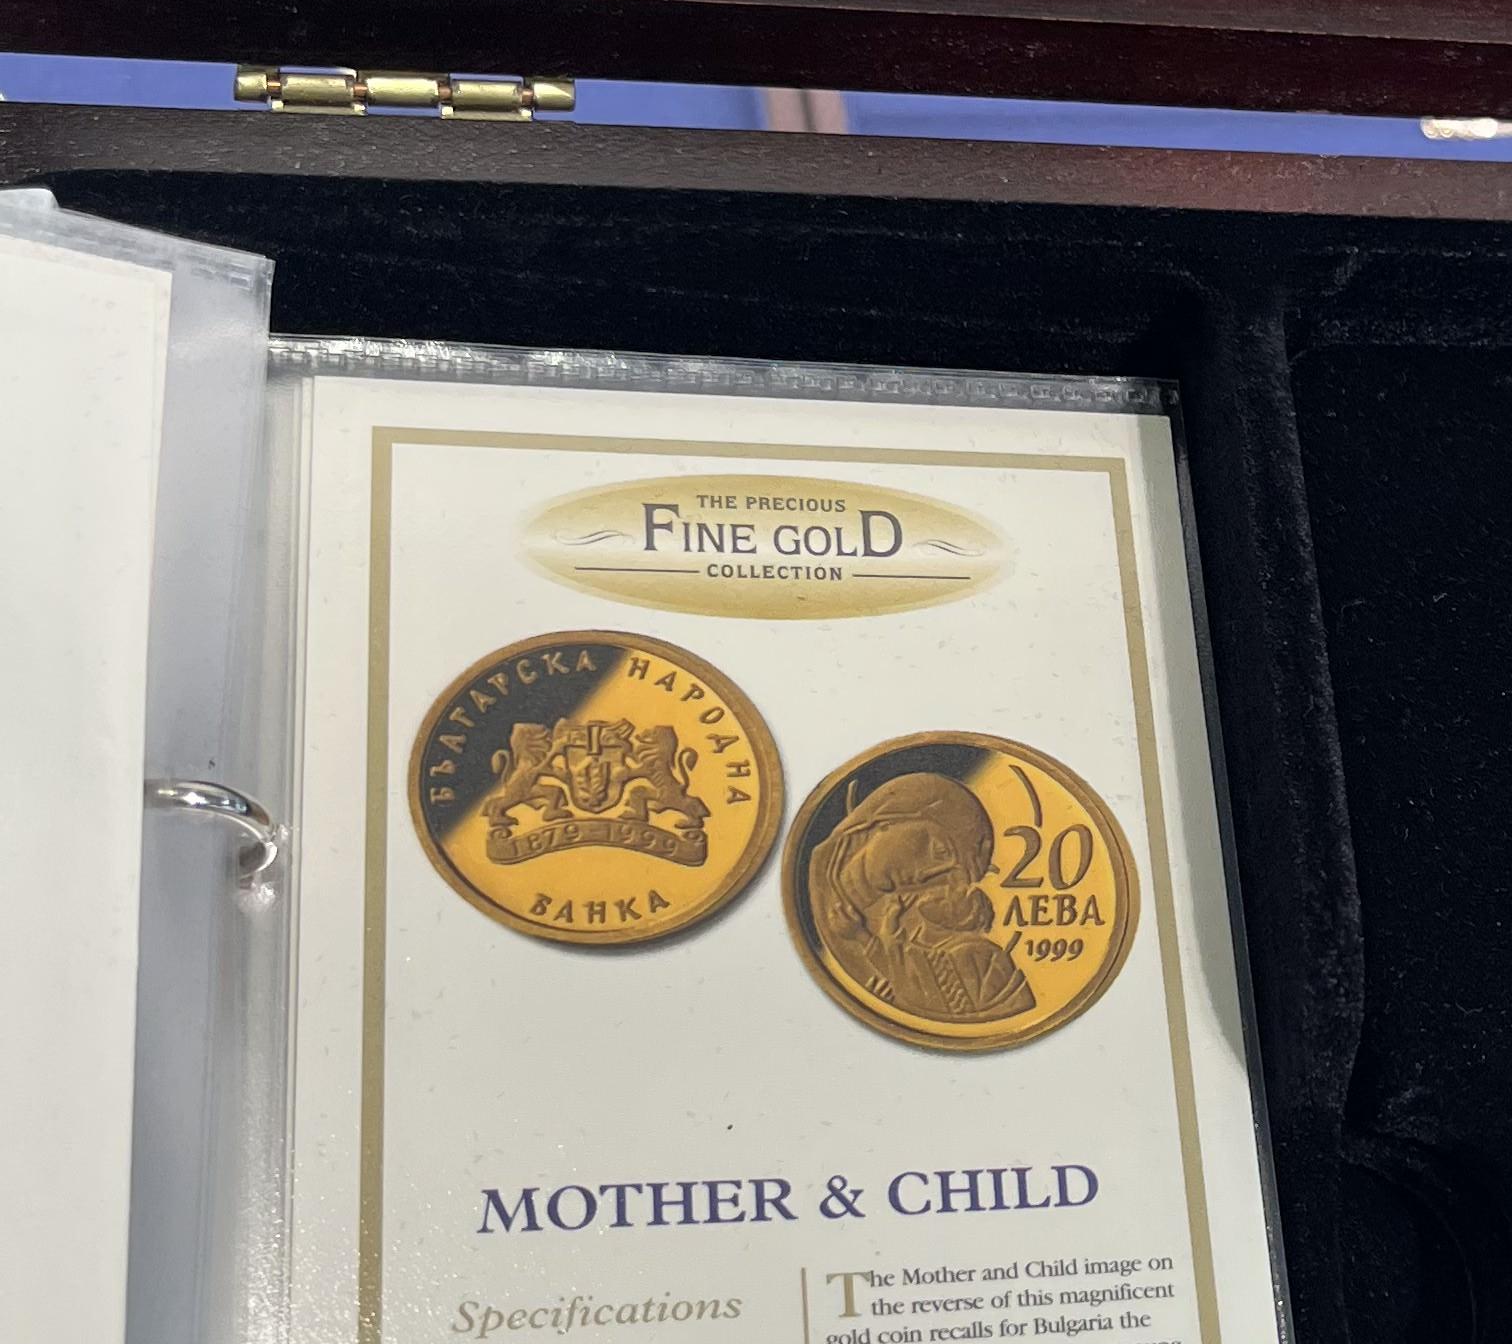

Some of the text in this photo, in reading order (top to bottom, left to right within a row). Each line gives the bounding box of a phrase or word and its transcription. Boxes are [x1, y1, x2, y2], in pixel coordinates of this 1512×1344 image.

[696, 494, 846, 513] THE PRECIOUS
[641, 503, 903, 558] FINE GOLD
[707, 563, 843, 581] COLLECTION
[1000, 823, 1094, 891] 20
[529, 889, 671, 925] БАНКА
[1024, 938, 1085, 962] 1999
[476, 1165, 1099, 1234] MOTHER & CHILD
[825, 1258, 1173, 1318] The Mother and Child image on
[872, 1283, 1174, 1316] the reverse of this magnificent
[450, 1291, 744, 1339] Specifications
[878, 1327, 922, 1344] coin
[930, 1322, 992, 1341] recalls
[1000, 1319, 1028, 1337] for
[1034, 1314, 1113, 1336] Bulgaria
[1120, 1312, 1150, 1328] the
